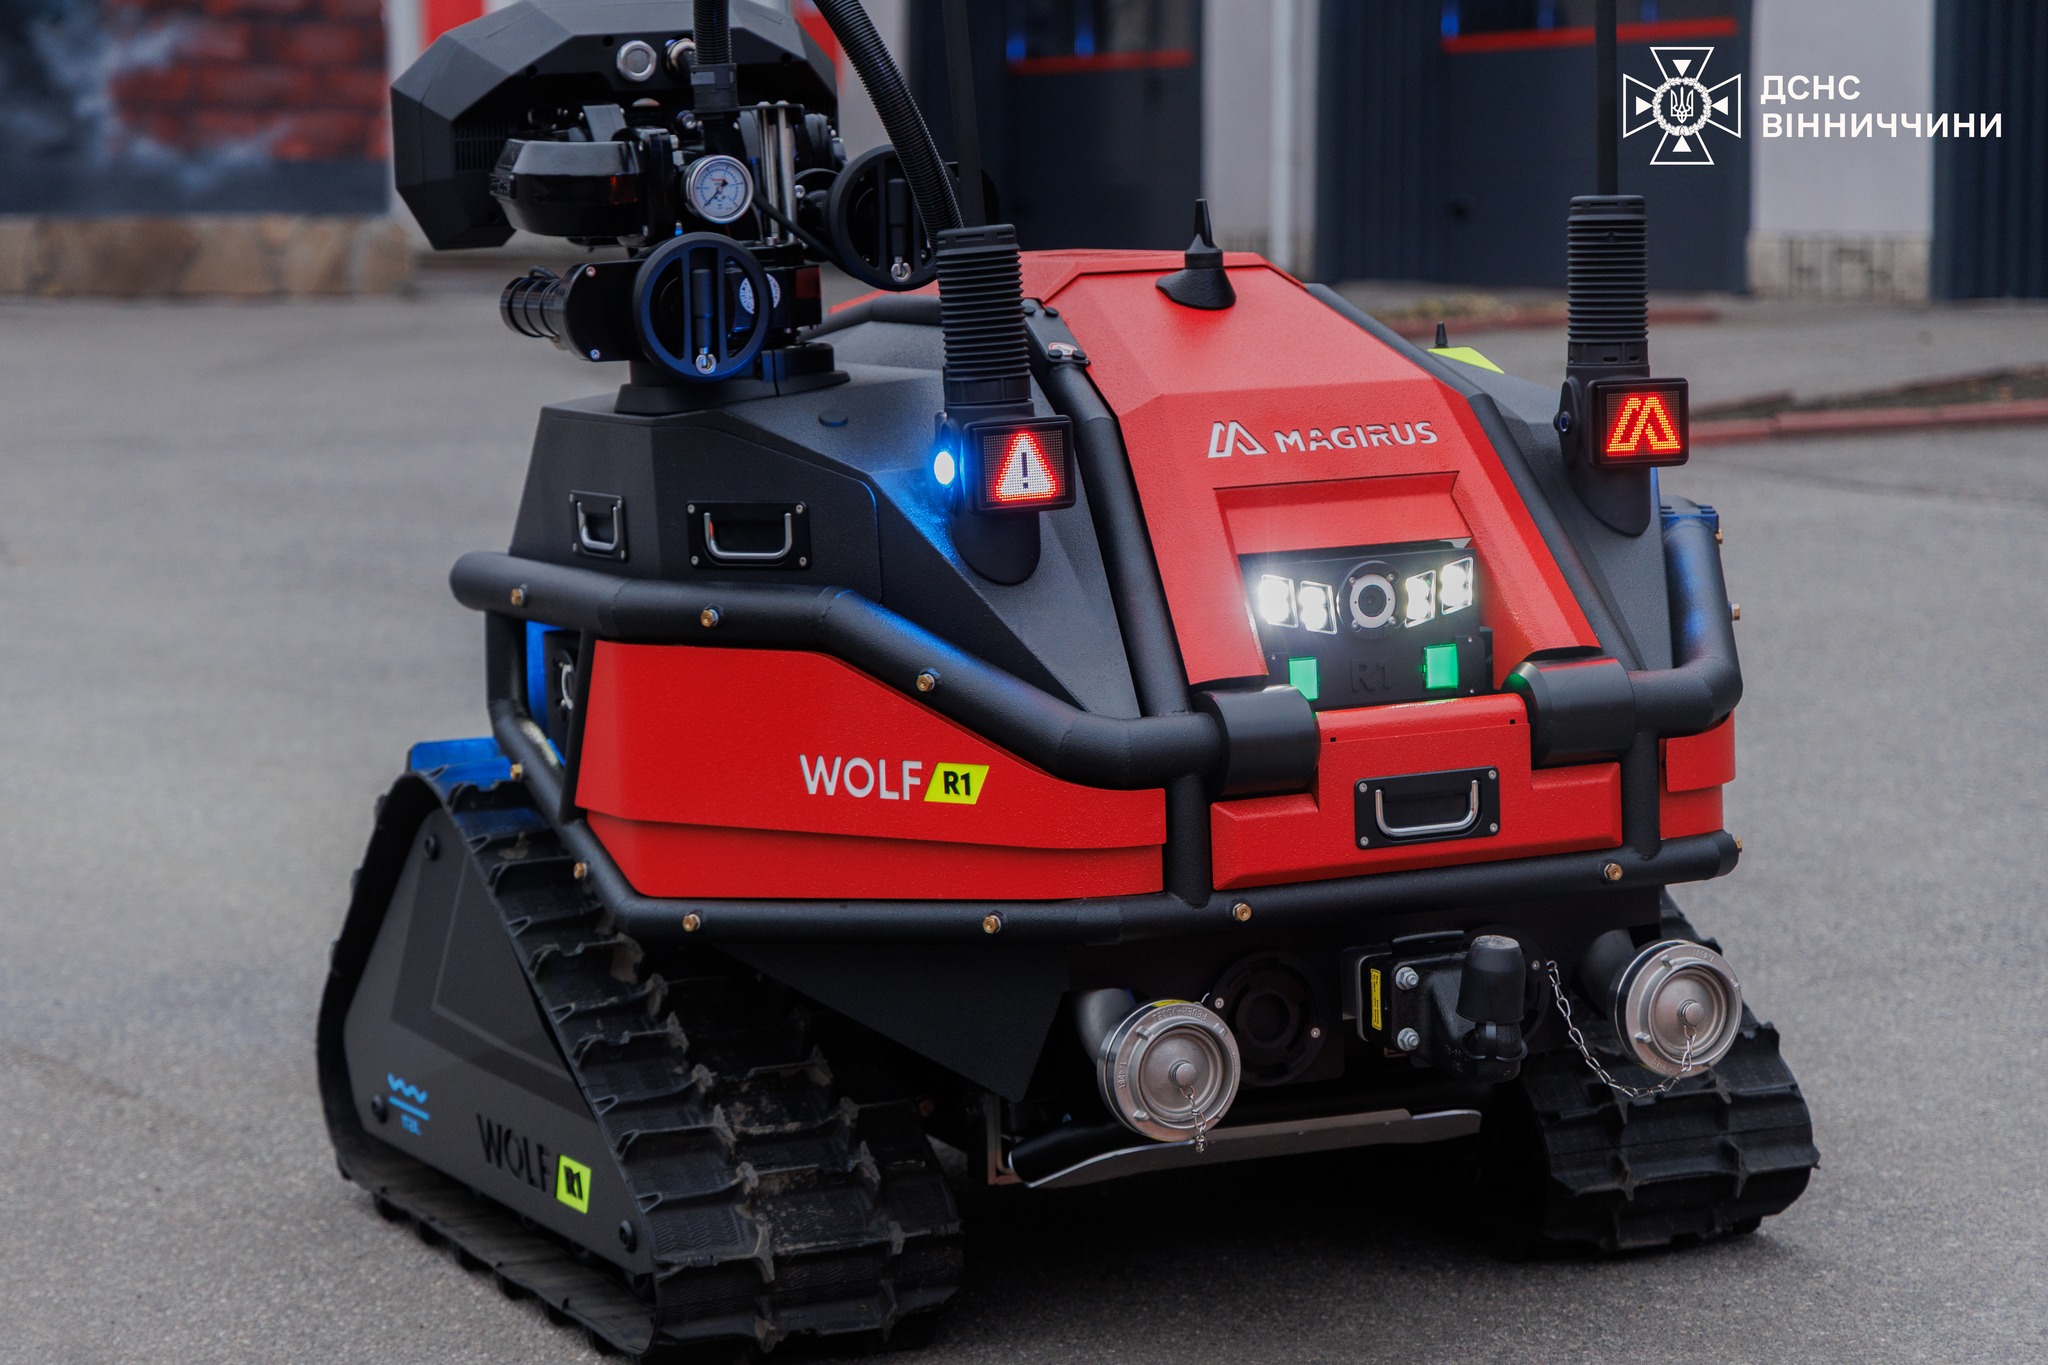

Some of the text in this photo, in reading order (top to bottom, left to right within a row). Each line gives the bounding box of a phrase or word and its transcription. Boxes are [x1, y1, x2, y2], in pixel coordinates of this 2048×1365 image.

[1274, 421, 1438, 453] MAGIRUS
[799, 754, 971, 801] WOLF R1
[476, 1113, 584, 1202] WOLF R1
